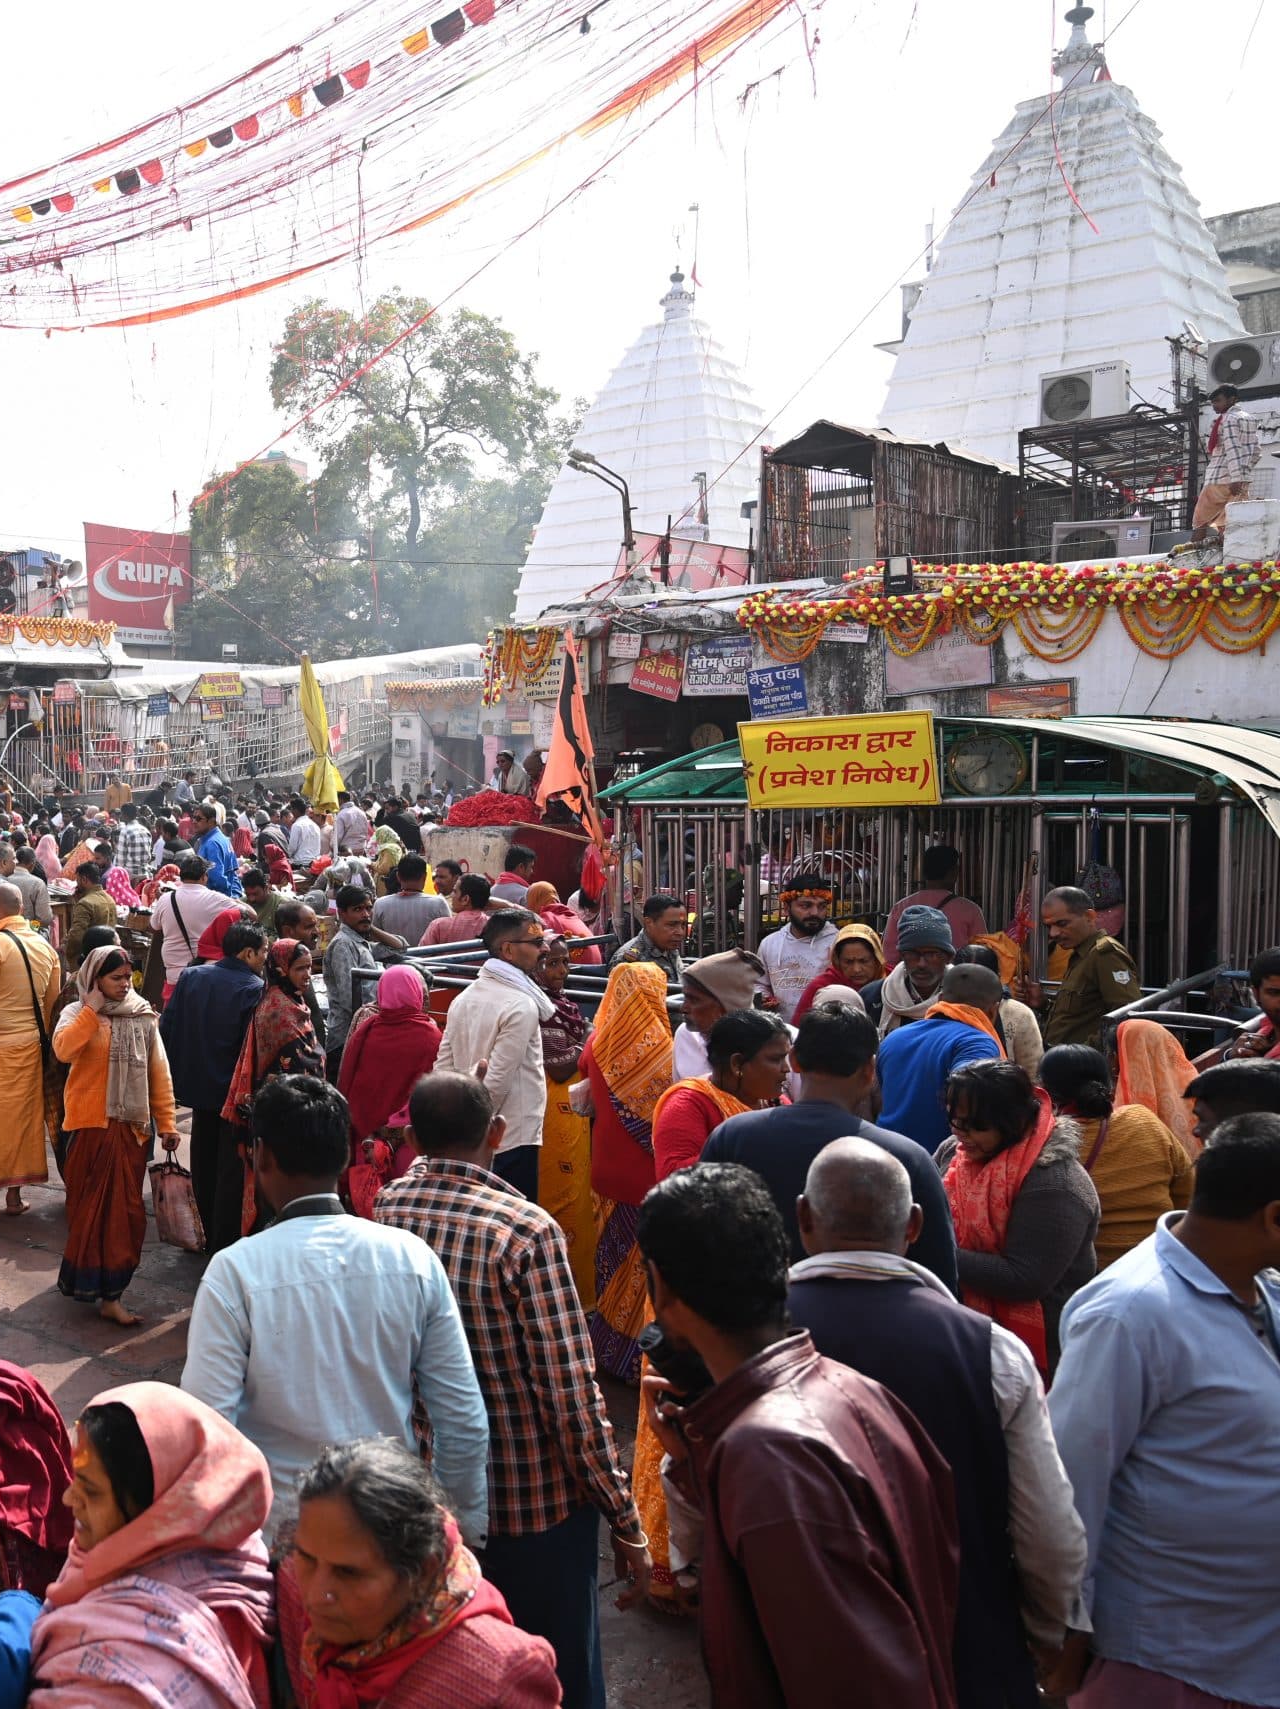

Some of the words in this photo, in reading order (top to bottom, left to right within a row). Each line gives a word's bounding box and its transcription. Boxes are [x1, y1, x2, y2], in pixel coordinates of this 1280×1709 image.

[117, 560, 183, 587] RUPA
[722, 654, 747, 668] पंडा
[775, 666, 801, 681] पंडा
[765, 731, 861, 755] निकास
[866, 730, 917, 754] द्वार
[758, 763, 836, 794] (प्रवेश
[841, 758, 930, 790] निषेध)
